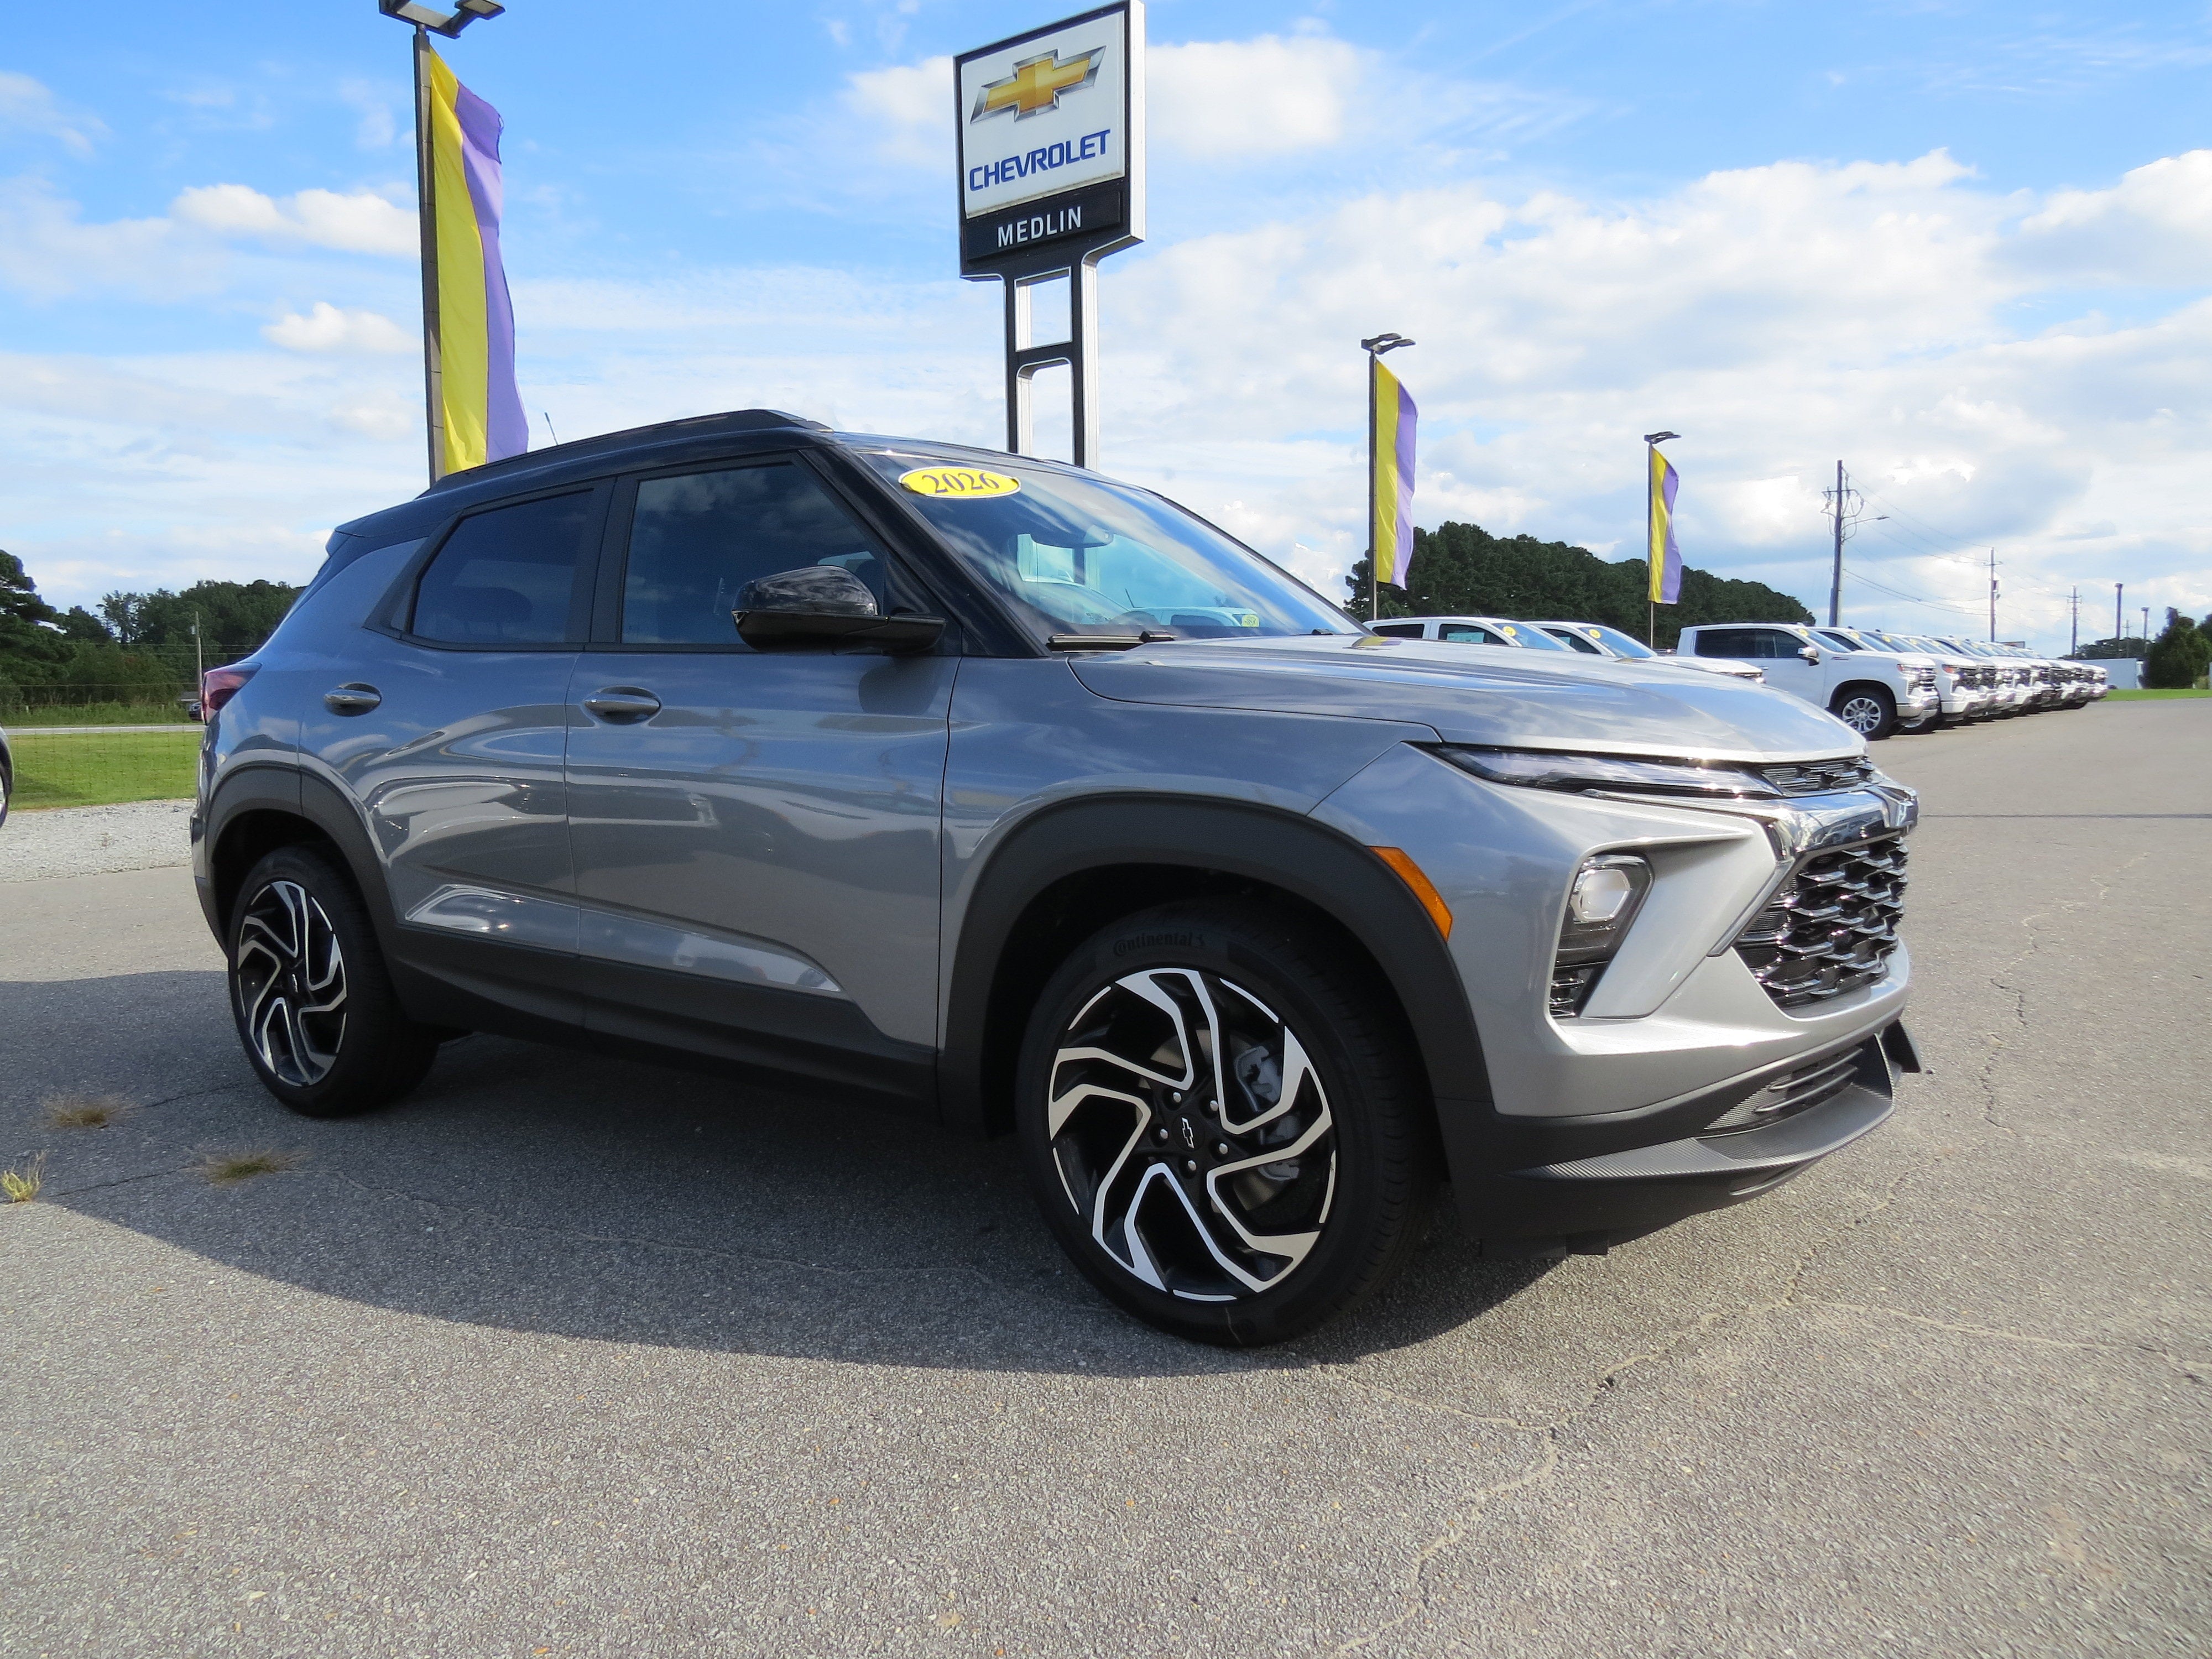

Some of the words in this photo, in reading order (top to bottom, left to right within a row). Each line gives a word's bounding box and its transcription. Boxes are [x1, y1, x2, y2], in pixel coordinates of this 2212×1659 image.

[969, 129, 1110, 191] CHEVROLET
[998, 206, 1081, 248] MEDLIN
[922, 472, 999, 493] 2026
[1113, 932, 1193, 957] Continental
